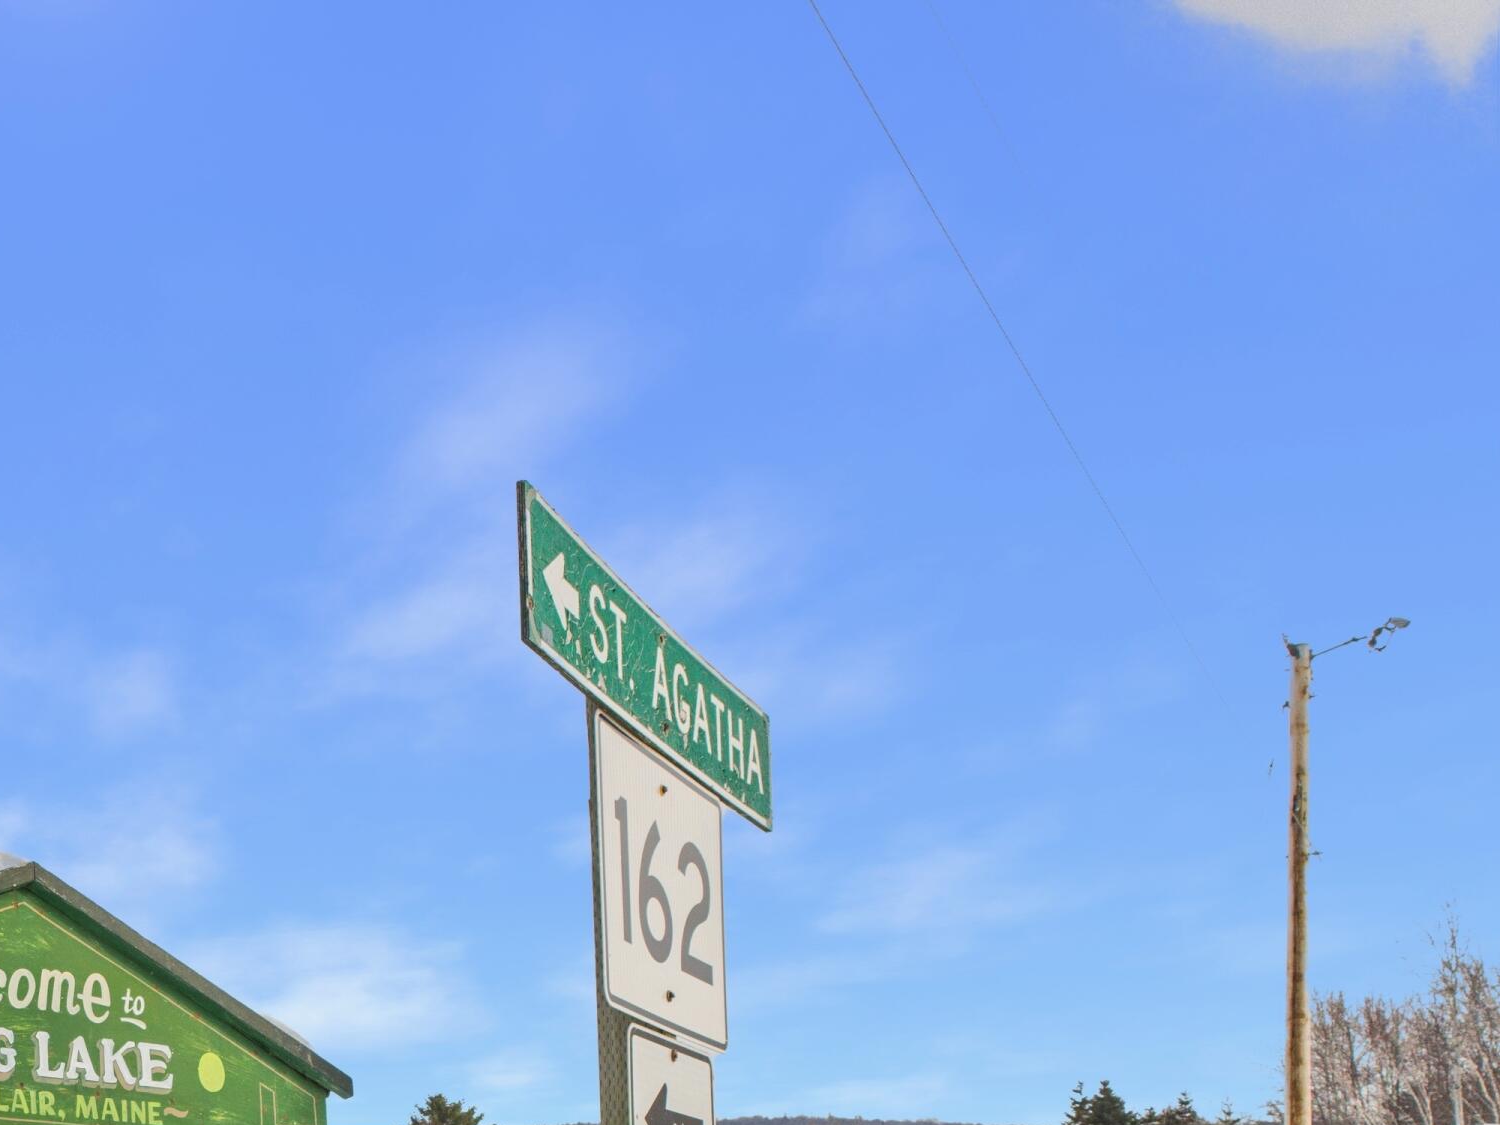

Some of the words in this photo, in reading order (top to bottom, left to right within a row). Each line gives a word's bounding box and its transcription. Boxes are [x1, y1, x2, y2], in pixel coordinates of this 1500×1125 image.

[589, 585, 635, 690] ST.
[652, 647, 764, 795] AGATHA
[614, 796, 714, 986] 162
[34, 1031, 174, 1092] LAKE
[121, 988, 146, 1016] to
